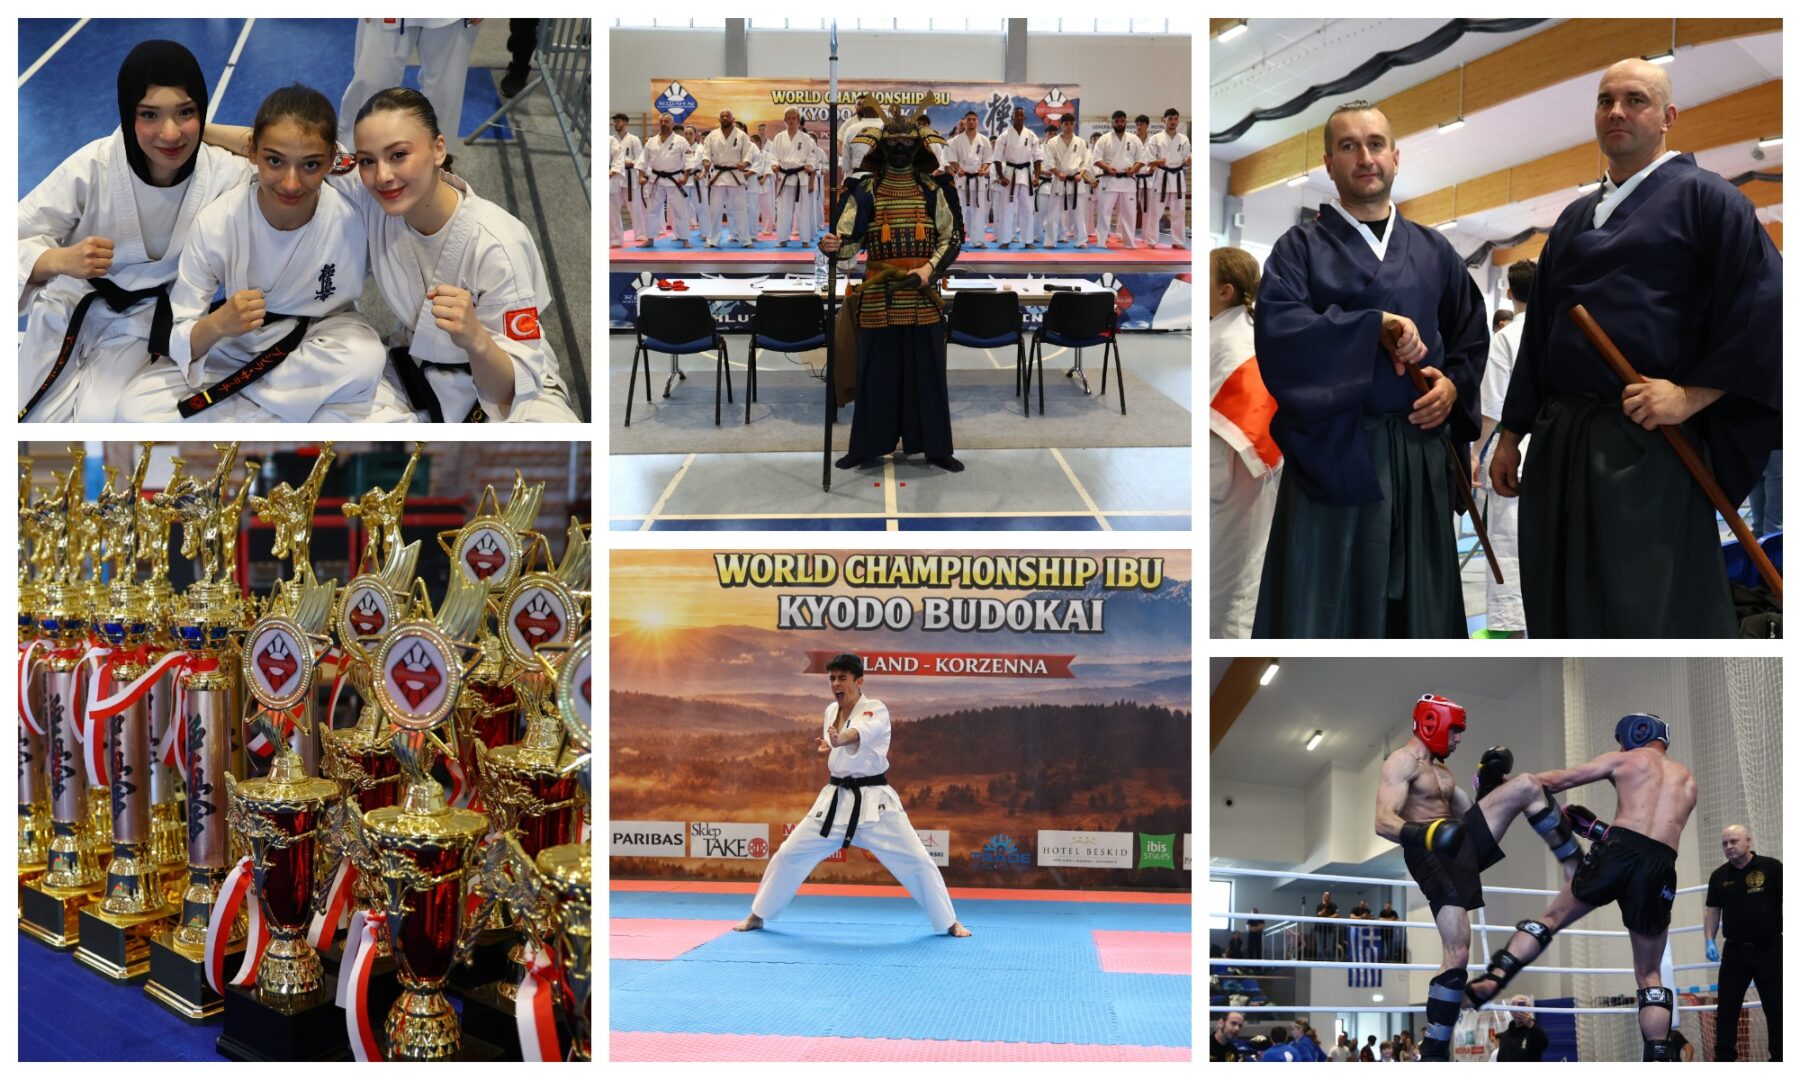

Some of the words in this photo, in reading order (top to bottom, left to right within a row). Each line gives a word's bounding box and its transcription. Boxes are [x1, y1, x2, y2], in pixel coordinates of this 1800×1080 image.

[772, 90, 821, 105] WORLD
[714, 553, 839, 588] WORLD
[844, 554, 1097, 591] CHAMPIONSHIP
[1103, 556, 1164, 591] IBU
[778, 594, 914, 631] KYODO
[924, 596, 1104, 633] BUDOKAI
[863, 656, 919, 673] LAND
[935, 657, 1048, 674] KORZENNA
[613, 832, 684, 846] PARIBAS
[691, 823, 722, 840] Sklep
[703, 838, 748, 858] TAKE
[1043, 847, 1080, 856] HOTEL
[1086, 849, 1128, 857] BESKID
[1147, 840, 1167, 852] ibis
